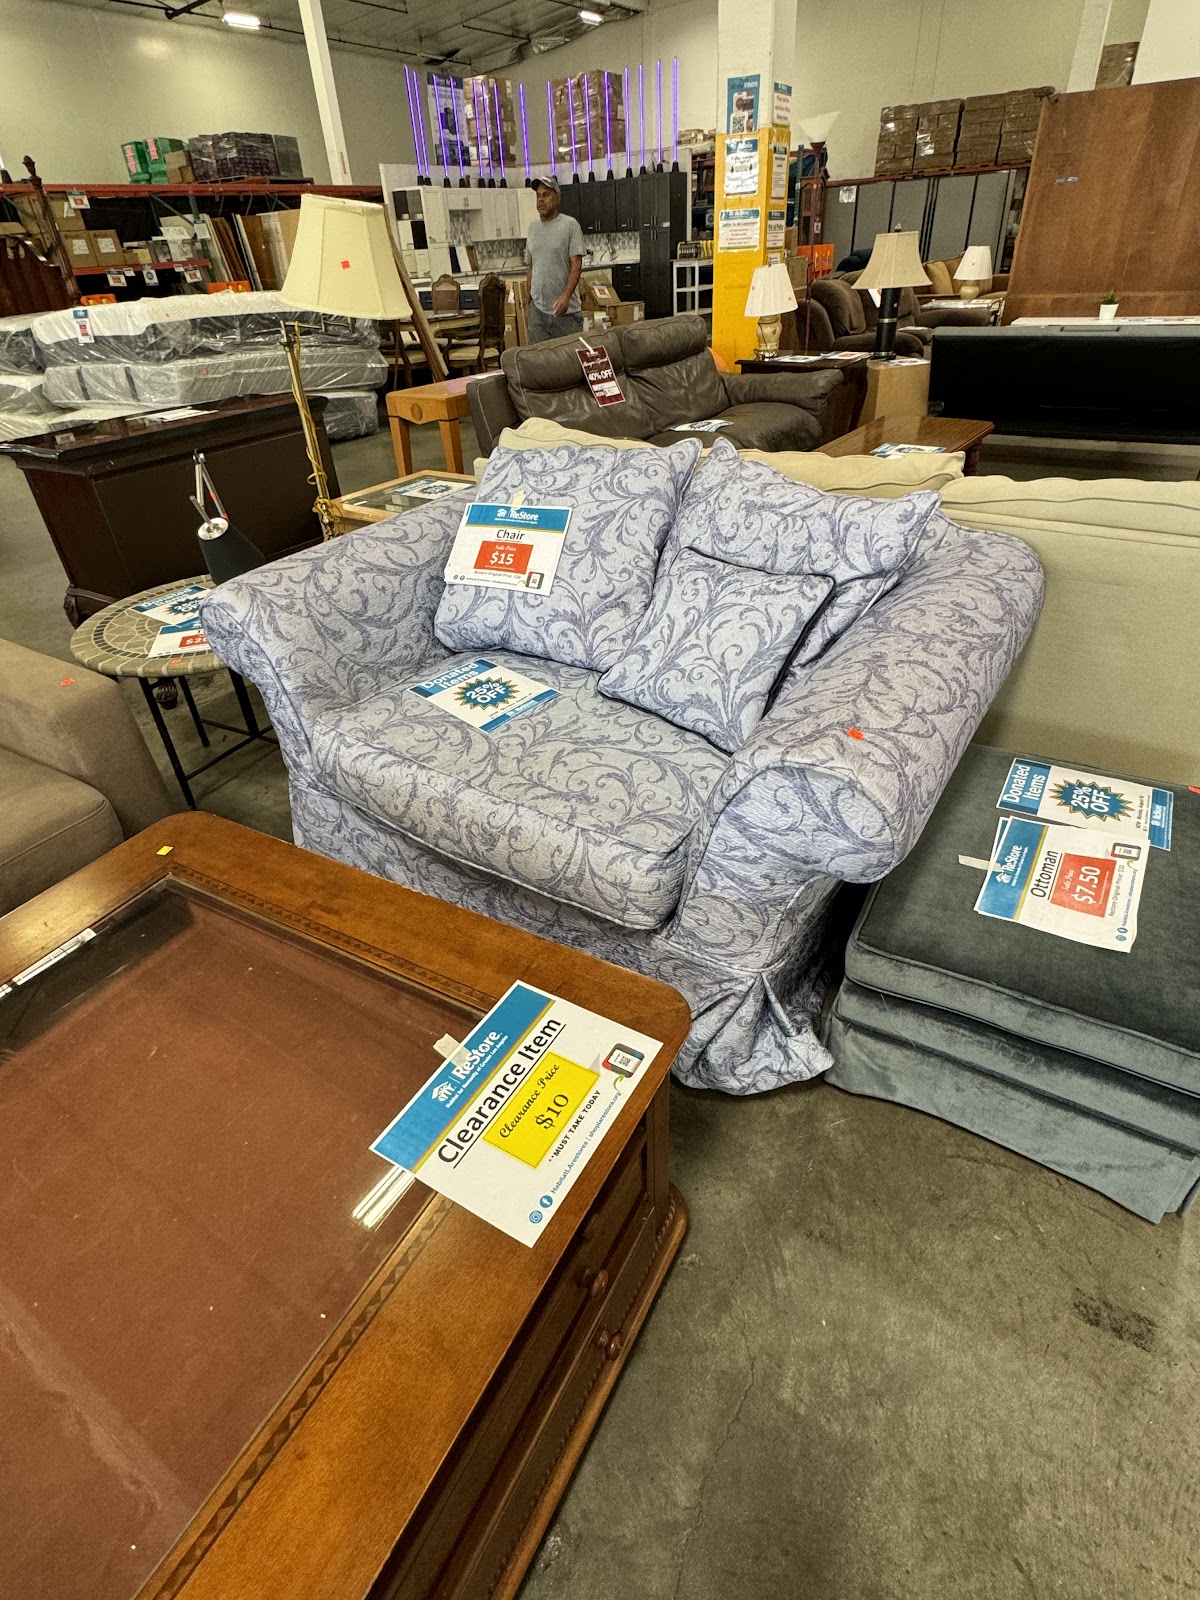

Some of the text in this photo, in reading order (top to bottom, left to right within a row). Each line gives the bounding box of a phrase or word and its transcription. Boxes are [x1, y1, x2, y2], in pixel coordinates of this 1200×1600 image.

[588, 369, 612, 381] 40% OFF
[510, 510, 539, 520] ReStore
[496, 529, 525, 540] Chair
[490, 550, 514, 566] $15
[420, 663, 479, 689] Donated
[437, 670, 479, 688] Items
[466, 682, 500, 699] 25%
[477, 686, 506, 703] OFF
[1003, 763, 1030, 803] Donated
[1022, 774, 1046, 800] Items
[1072, 786, 1092, 809] 25%
[1090, 790, 1111, 813] OFF
[1003, 846, 1021, 871] ReStore
[1031, 850, 1058, 898] Ottoman
[1064, 868, 1073, 880] Price
[1071, 866, 1101, 904] $7.50
[1112, 885, 1121, 900] Original
[451, 1031, 501, 1080] ReStore
[438, 1019, 561, 1163] Clearance Item
[499, 1064, 560, 1139] Clearance Price
[535, 1094, 568, 1130] $10
[568, 1114, 585, 1134] TAKE
[582, 1090, 600, 1113] TODAY
[551, 1141, 588, 1194] HabitatLArestores
